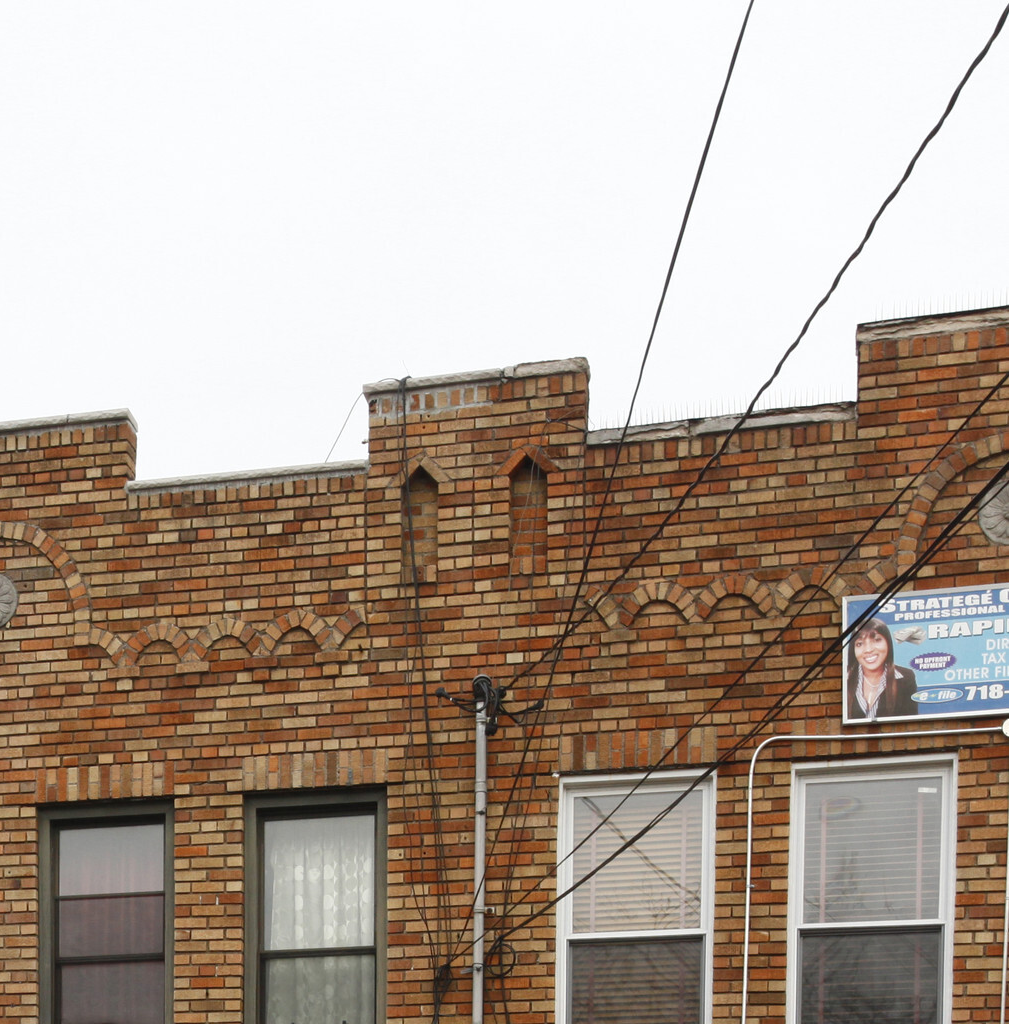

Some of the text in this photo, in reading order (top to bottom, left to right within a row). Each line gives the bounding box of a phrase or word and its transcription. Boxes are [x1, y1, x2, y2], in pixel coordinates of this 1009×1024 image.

[894, 605, 1006, 621] PROFESSIONAL
[928, 619, 1009, 640] RAPI
[982, 652, 1006, 665] TAX
[919, 662, 946, 670] PAYMENT
[944, 668, 989, 681] OTHER
